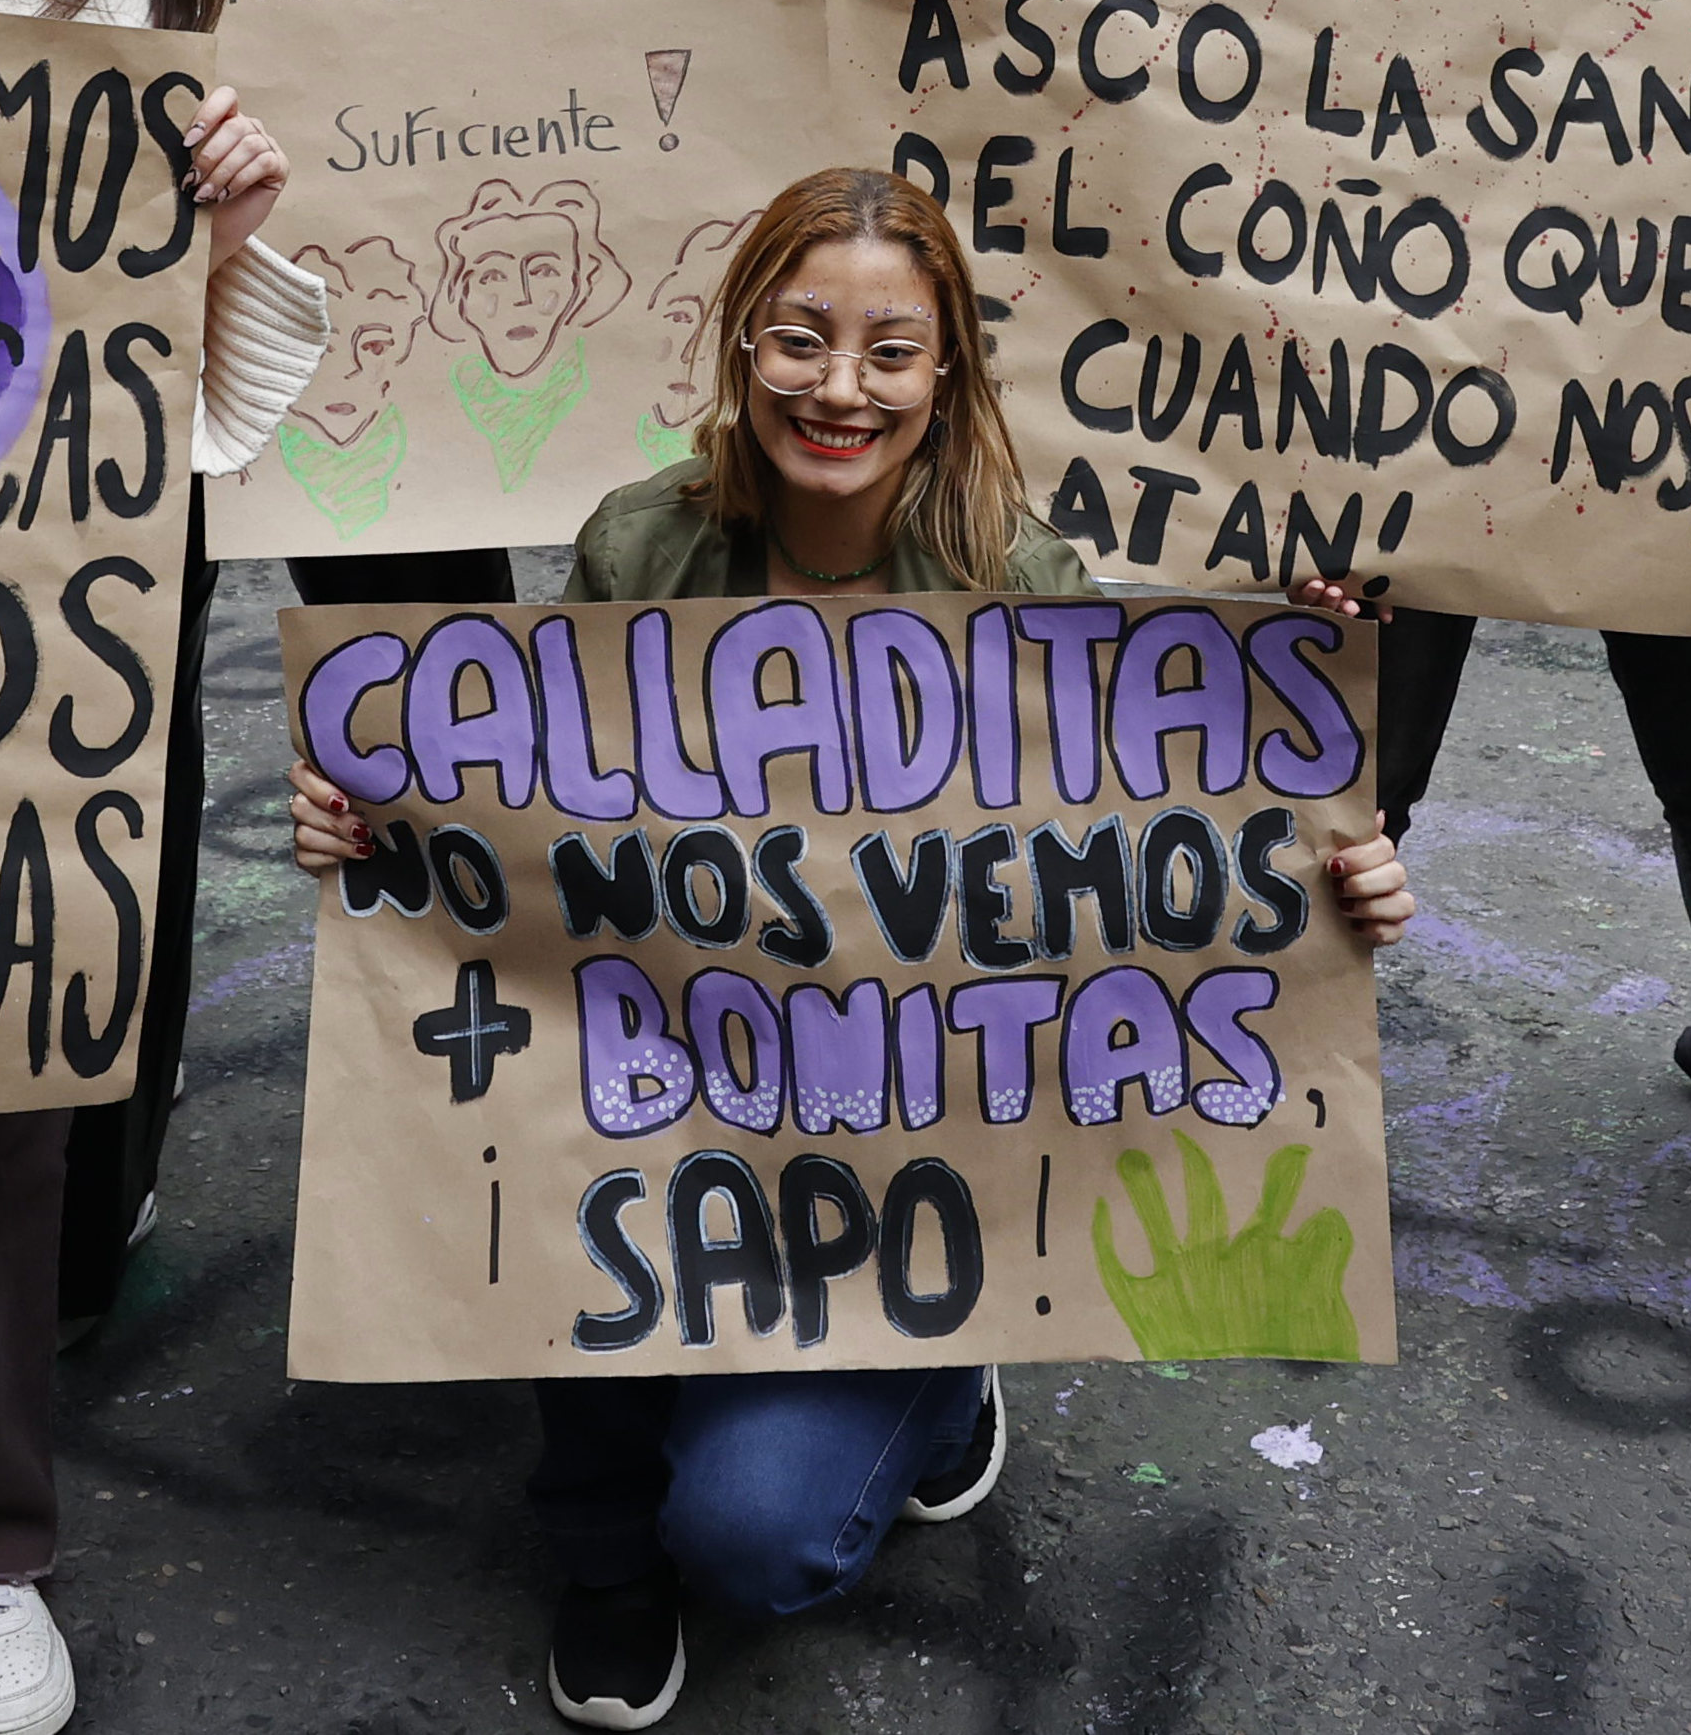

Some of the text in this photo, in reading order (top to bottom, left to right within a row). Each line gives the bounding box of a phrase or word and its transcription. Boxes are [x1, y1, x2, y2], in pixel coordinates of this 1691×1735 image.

[1304, 26, 1436, 162] LA
[890, 132, 1108, 258] DEL
[1164, 162, 1470, 320] COÑO
[1060, 318, 1518, 470] CUANDO
[1048, 456, 1414, 600] ATAN!
[300, 600, 1363, 821] CALLADITAS
[340, 804, 1310, 972] NO NOS VEMOS
[570, 1148, 984, 1352] SAPO
